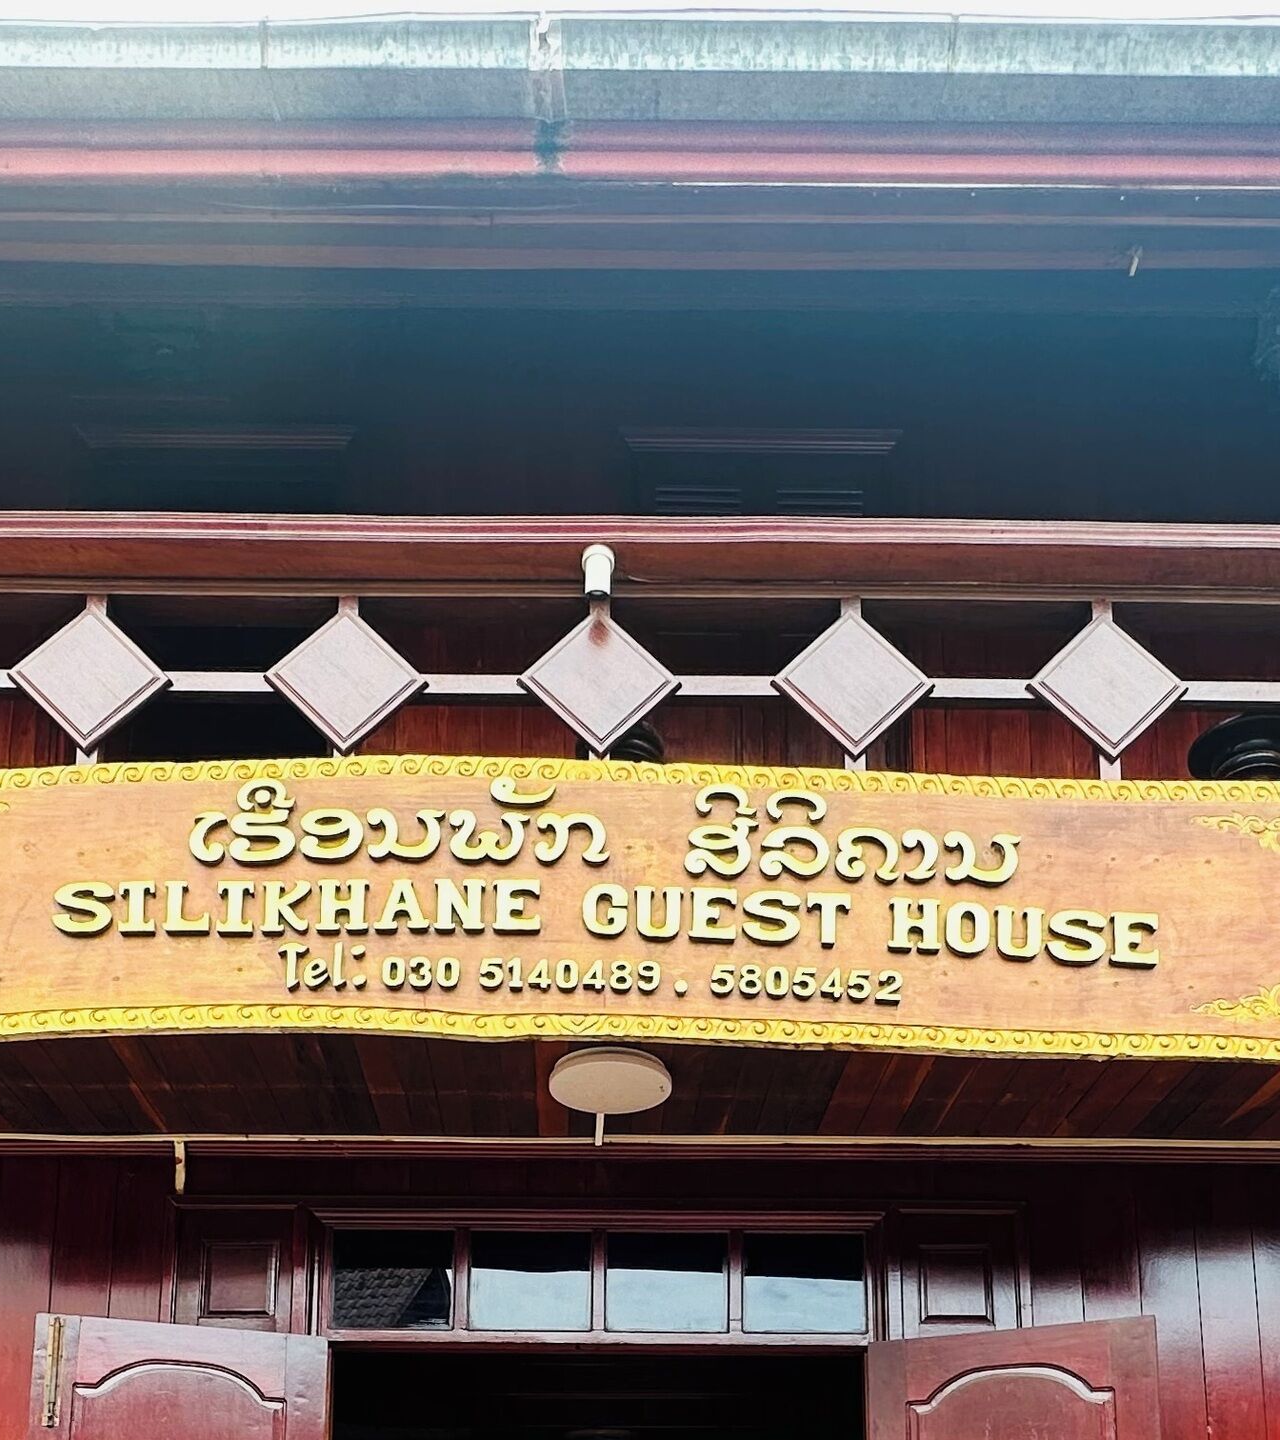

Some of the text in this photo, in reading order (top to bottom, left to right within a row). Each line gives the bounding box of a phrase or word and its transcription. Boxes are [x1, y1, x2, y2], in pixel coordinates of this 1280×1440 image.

[51, 878, 1160, 970] SILIKHANE GUEST HOUSE
[380, 955, 462, 989] 030
[478, 957, 662, 993] 5140489
[709, 963, 904, 1005] 5805452
